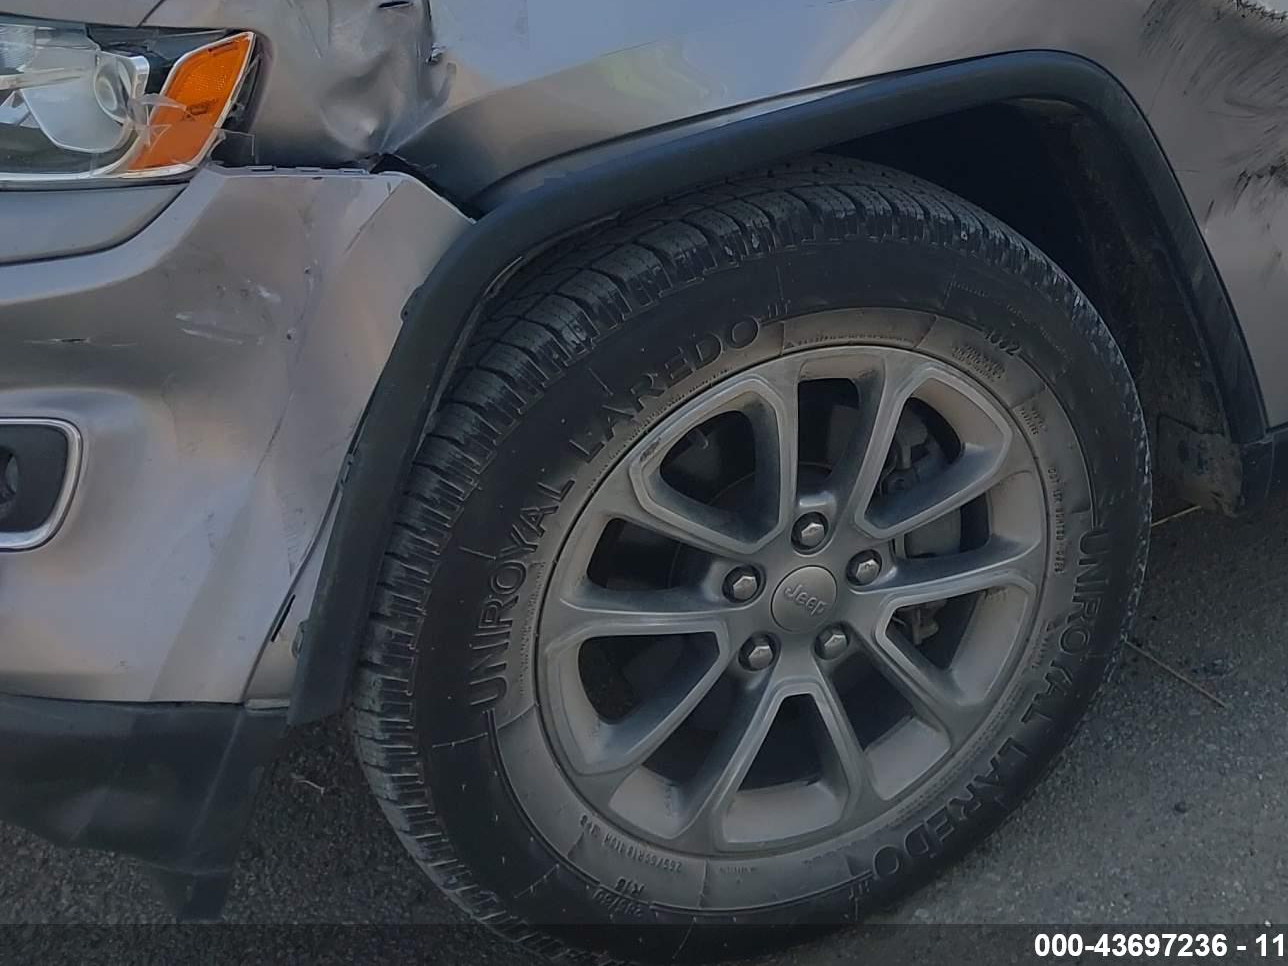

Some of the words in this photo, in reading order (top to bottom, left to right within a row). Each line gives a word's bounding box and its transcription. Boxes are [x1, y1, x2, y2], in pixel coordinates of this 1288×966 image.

[468, 477, 577, 706] UNIROYAL
[569, 315, 761, 464] LAREDO
[784, 584, 828, 616] Jeep
